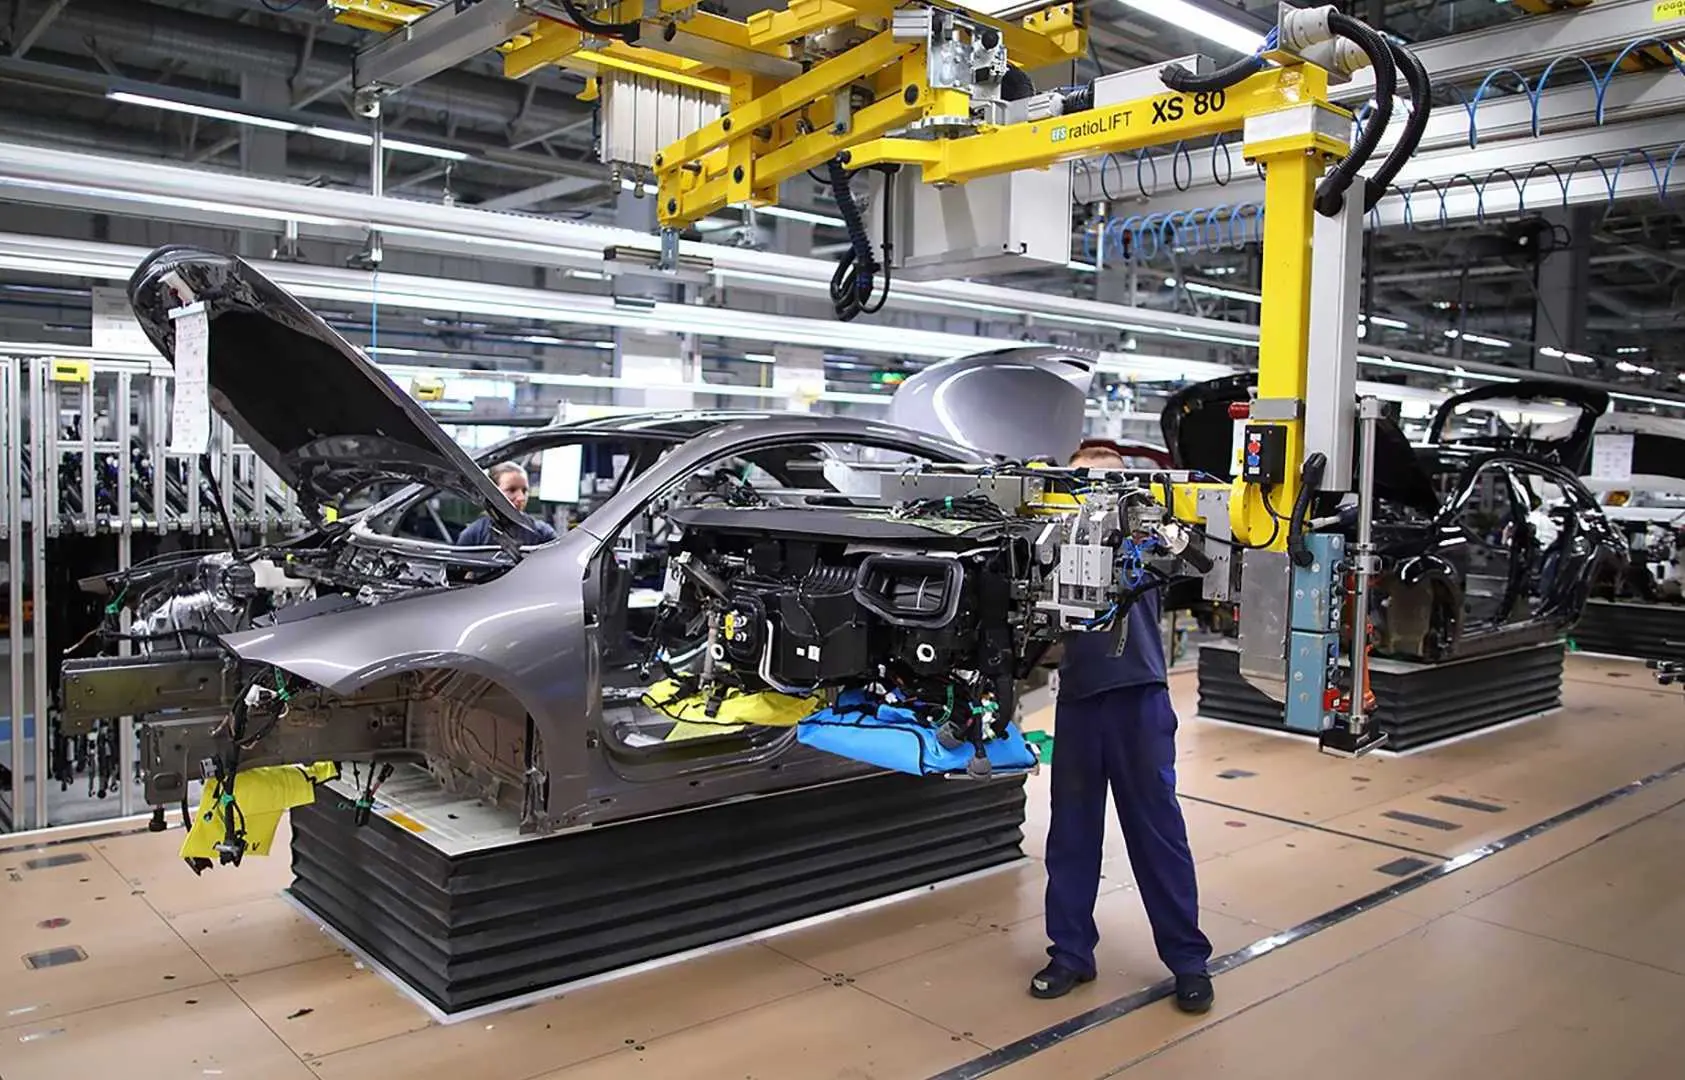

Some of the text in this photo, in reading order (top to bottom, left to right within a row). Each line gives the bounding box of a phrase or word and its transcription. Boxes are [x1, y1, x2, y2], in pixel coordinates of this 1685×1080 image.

[1069, 111, 1132, 139] ratioLIFT
[1152, 96, 1184, 125] XS
[1194, 89, 1226, 116] 80
